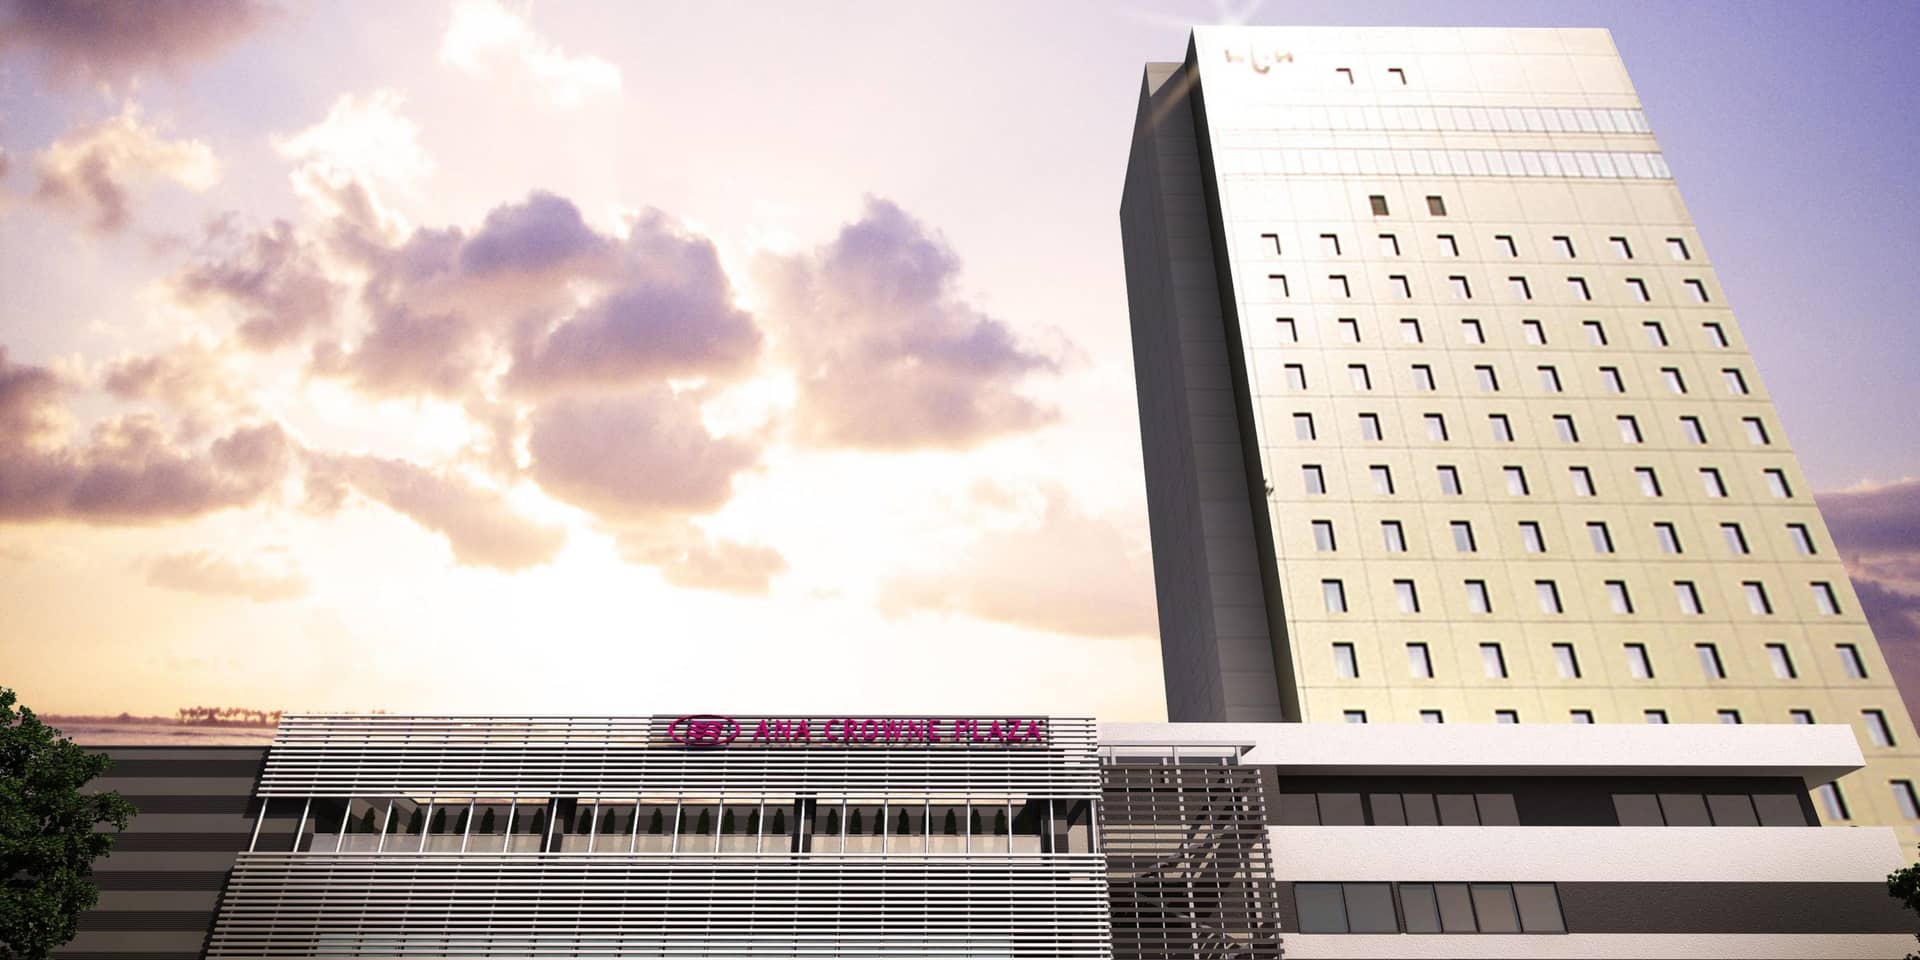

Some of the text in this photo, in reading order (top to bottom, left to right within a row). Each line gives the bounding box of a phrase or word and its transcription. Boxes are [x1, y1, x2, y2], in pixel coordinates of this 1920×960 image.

[753, 719, 1042, 742] ANA CROWNE PLAZA
